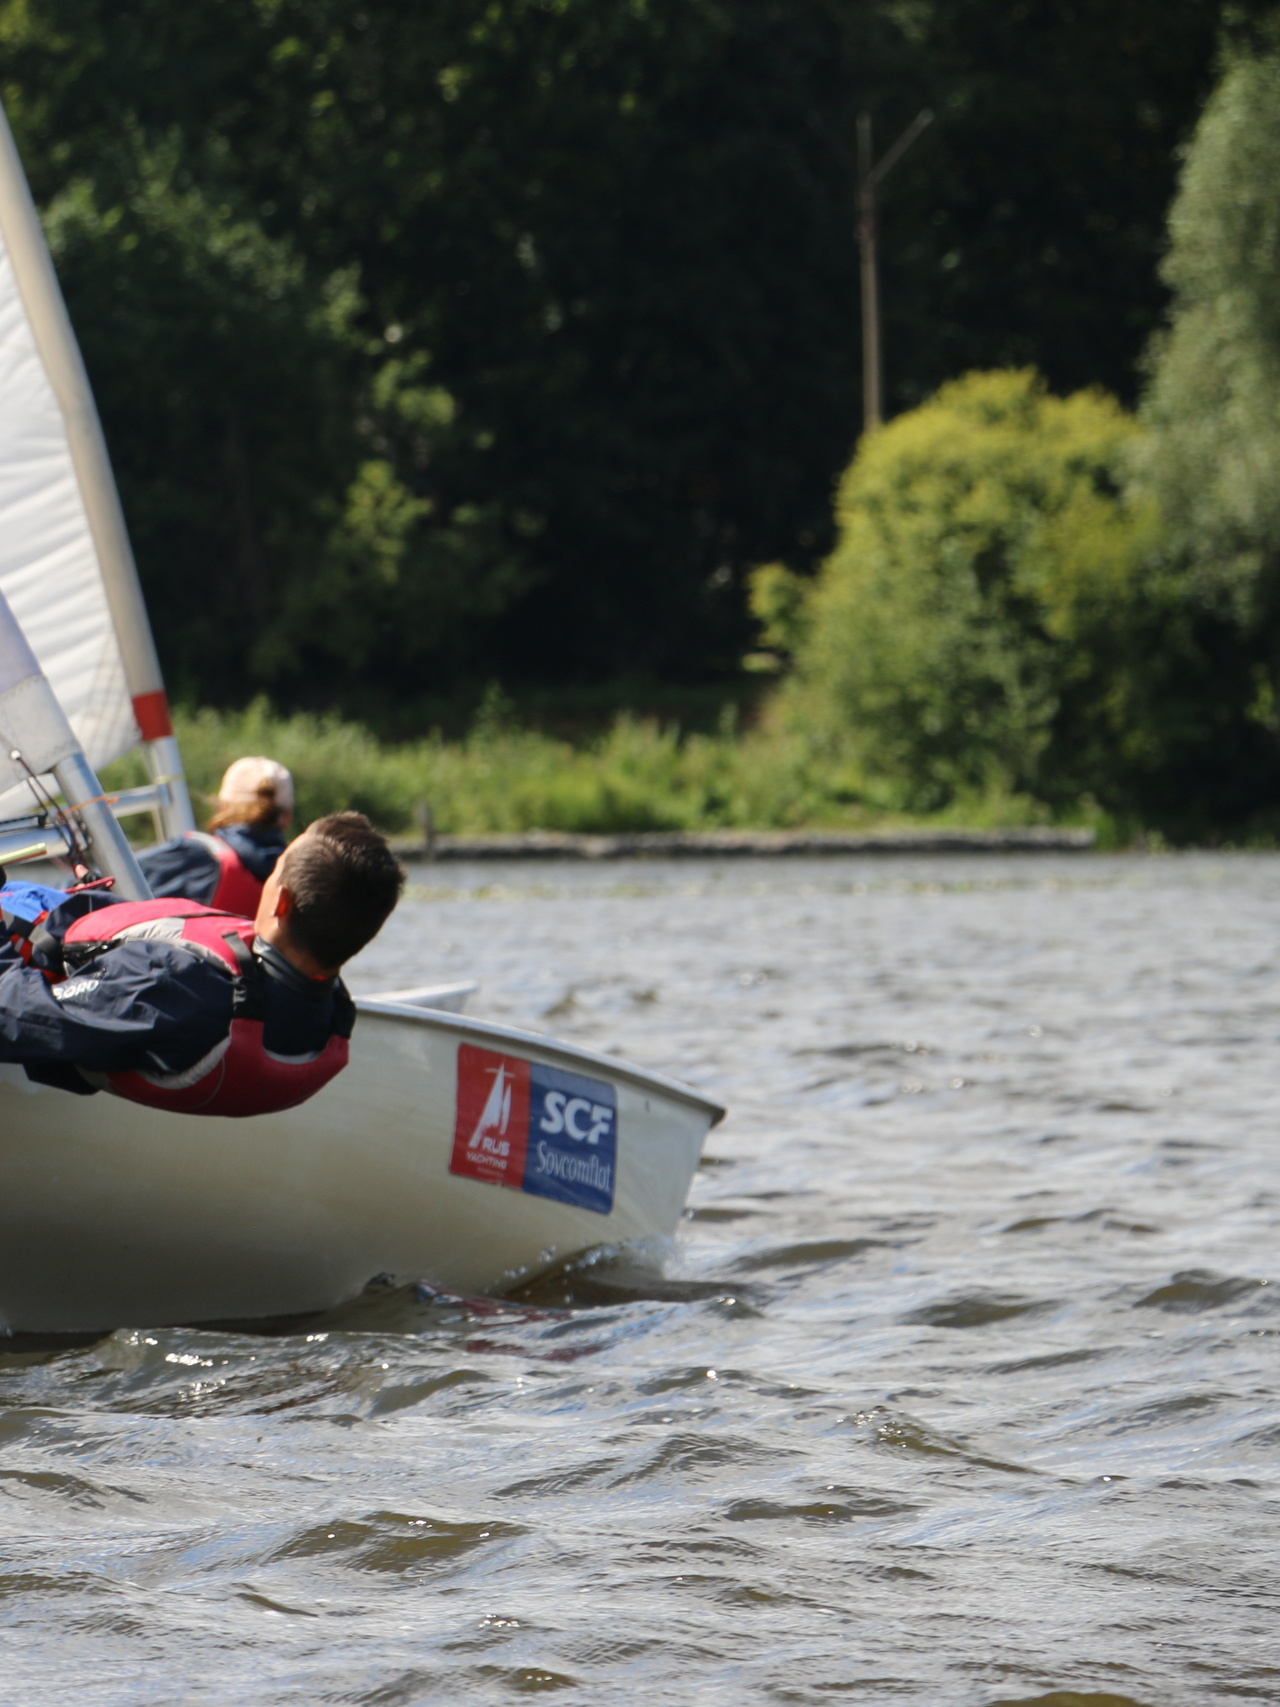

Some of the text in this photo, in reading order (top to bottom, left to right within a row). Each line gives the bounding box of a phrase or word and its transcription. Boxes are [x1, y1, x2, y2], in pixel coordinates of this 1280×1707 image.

[540, 1091, 613, 1145] SCF
[466, 1151, 508, 1170] YACHTING
[536, 1140, 612, 1192] Sovcomflot
